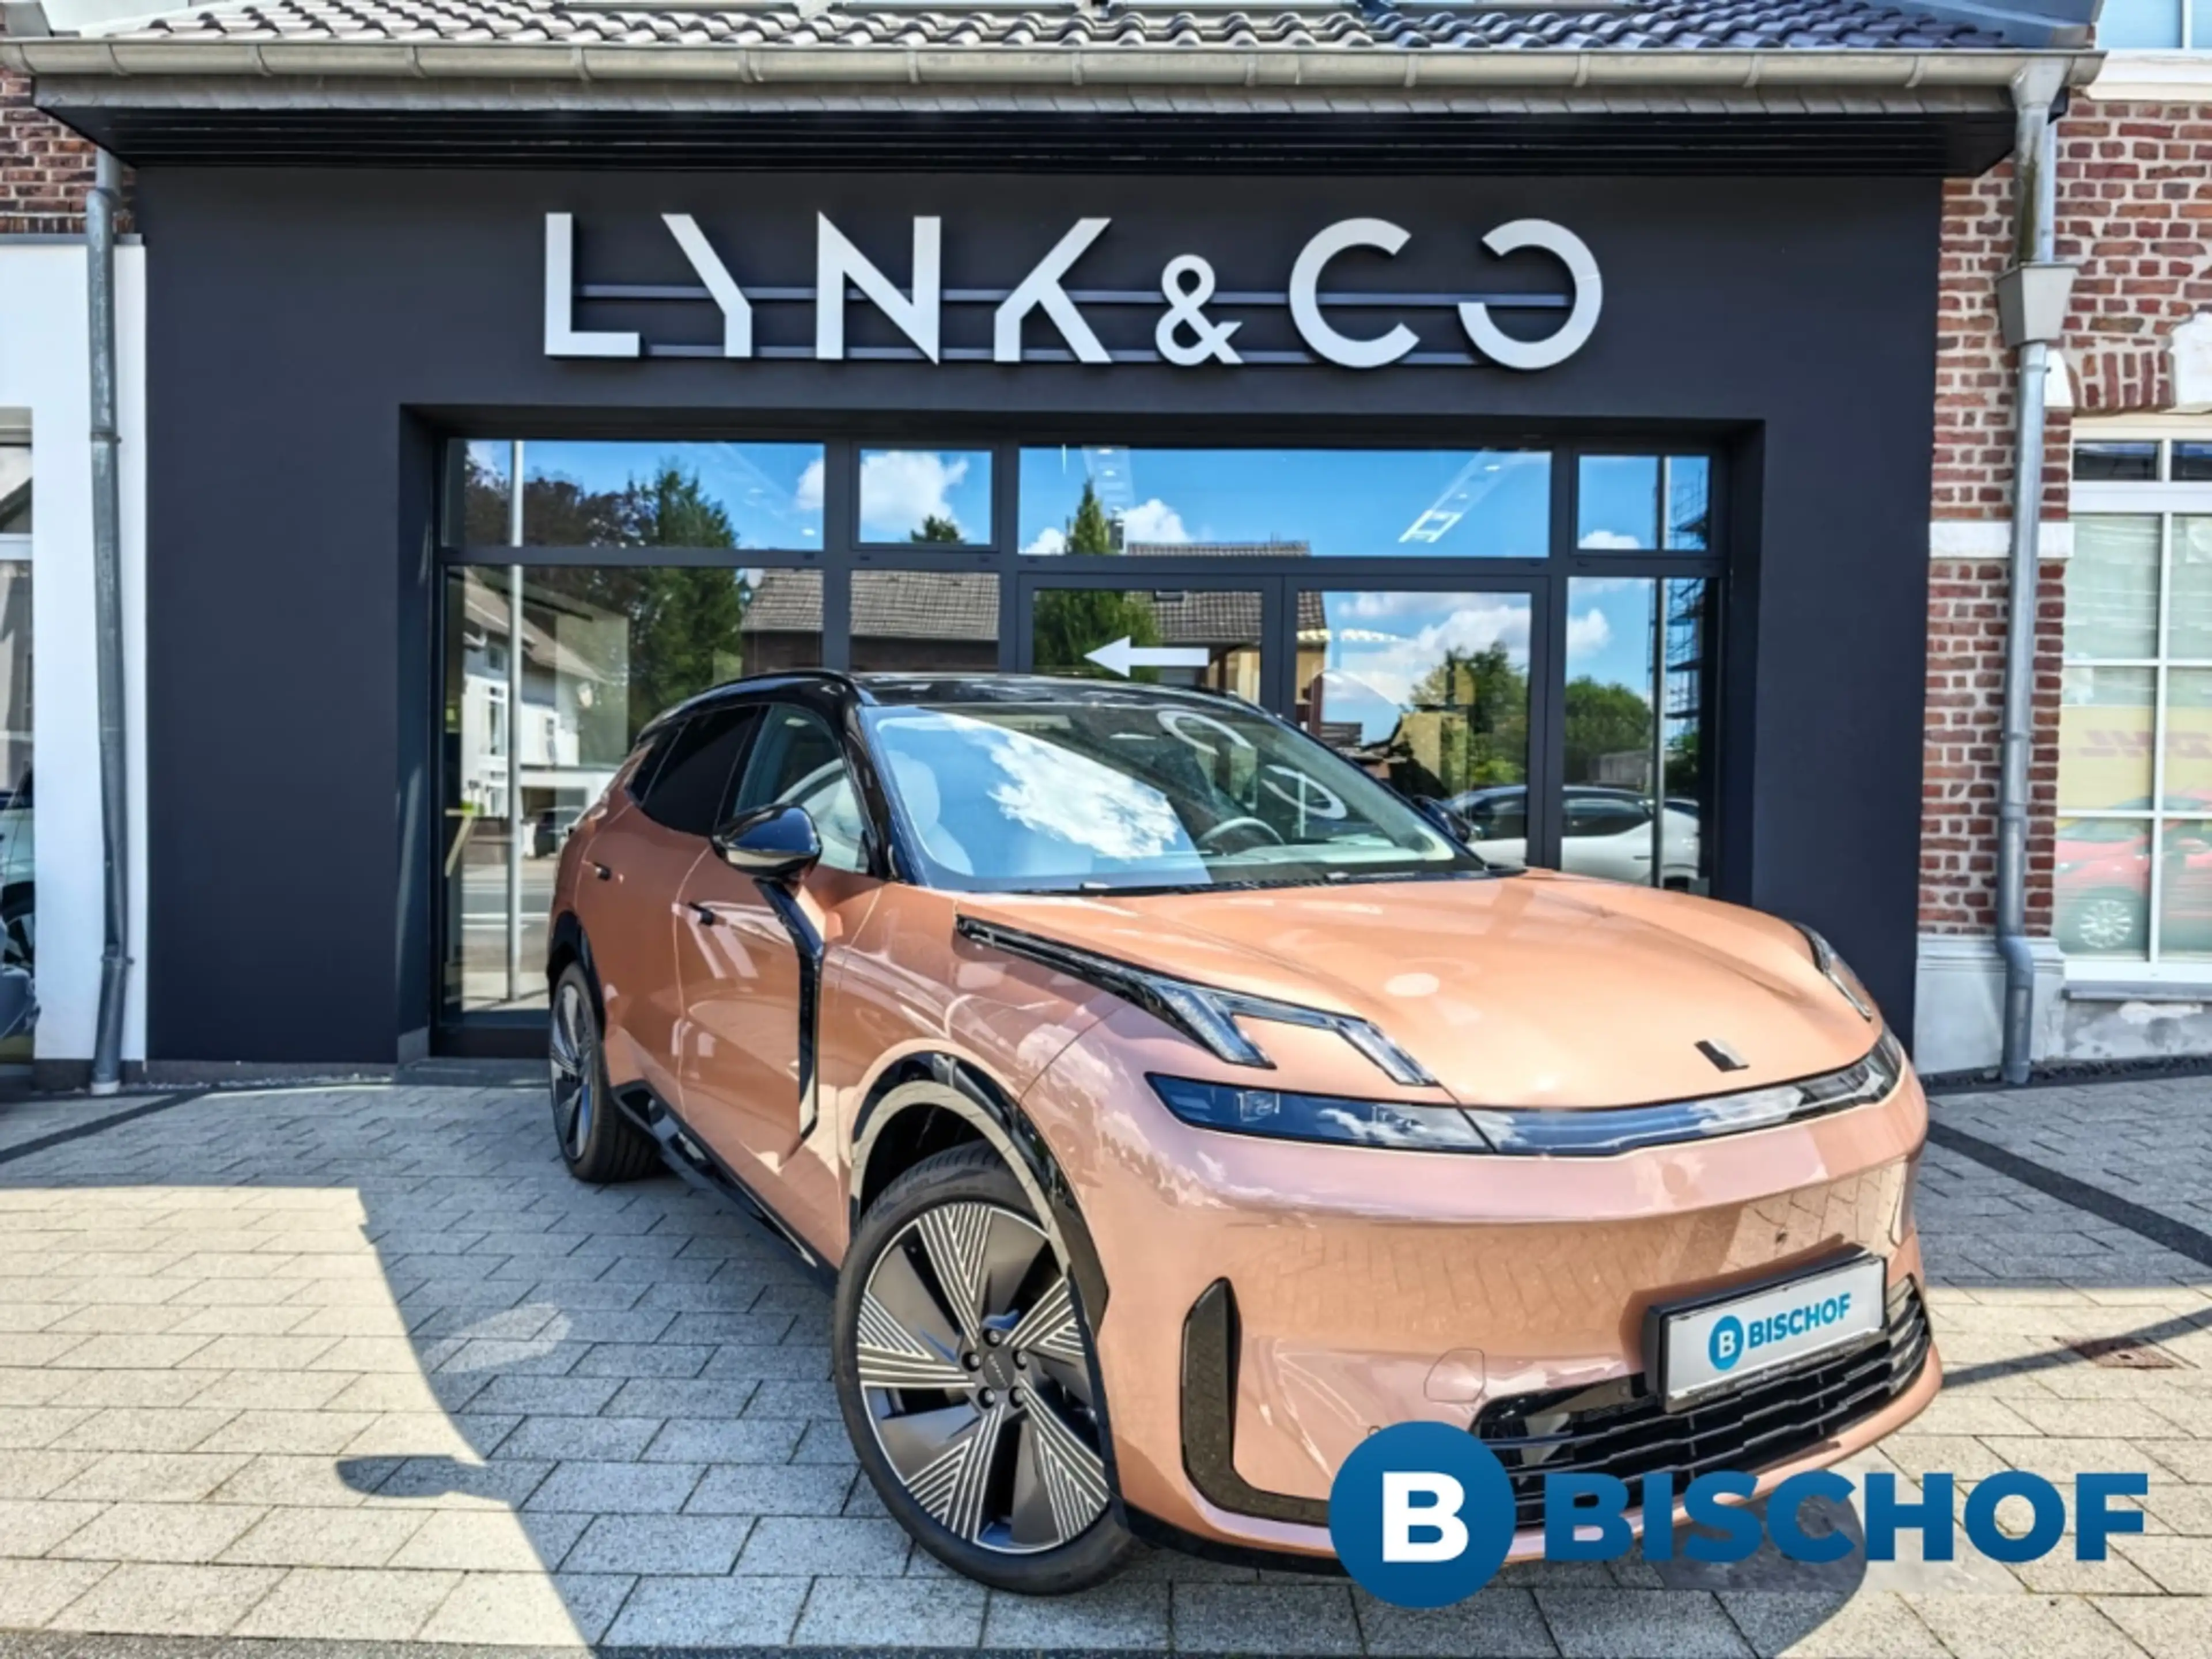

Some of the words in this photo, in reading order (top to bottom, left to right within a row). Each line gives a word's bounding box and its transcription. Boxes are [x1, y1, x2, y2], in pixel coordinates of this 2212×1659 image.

[544, 210, 1112, 366] LYNK
[1155, 253, 1245, 366] &
[1289, 217, 1604, 370] CO
[1748, 1293, 1851, 1349] BISCHOF
